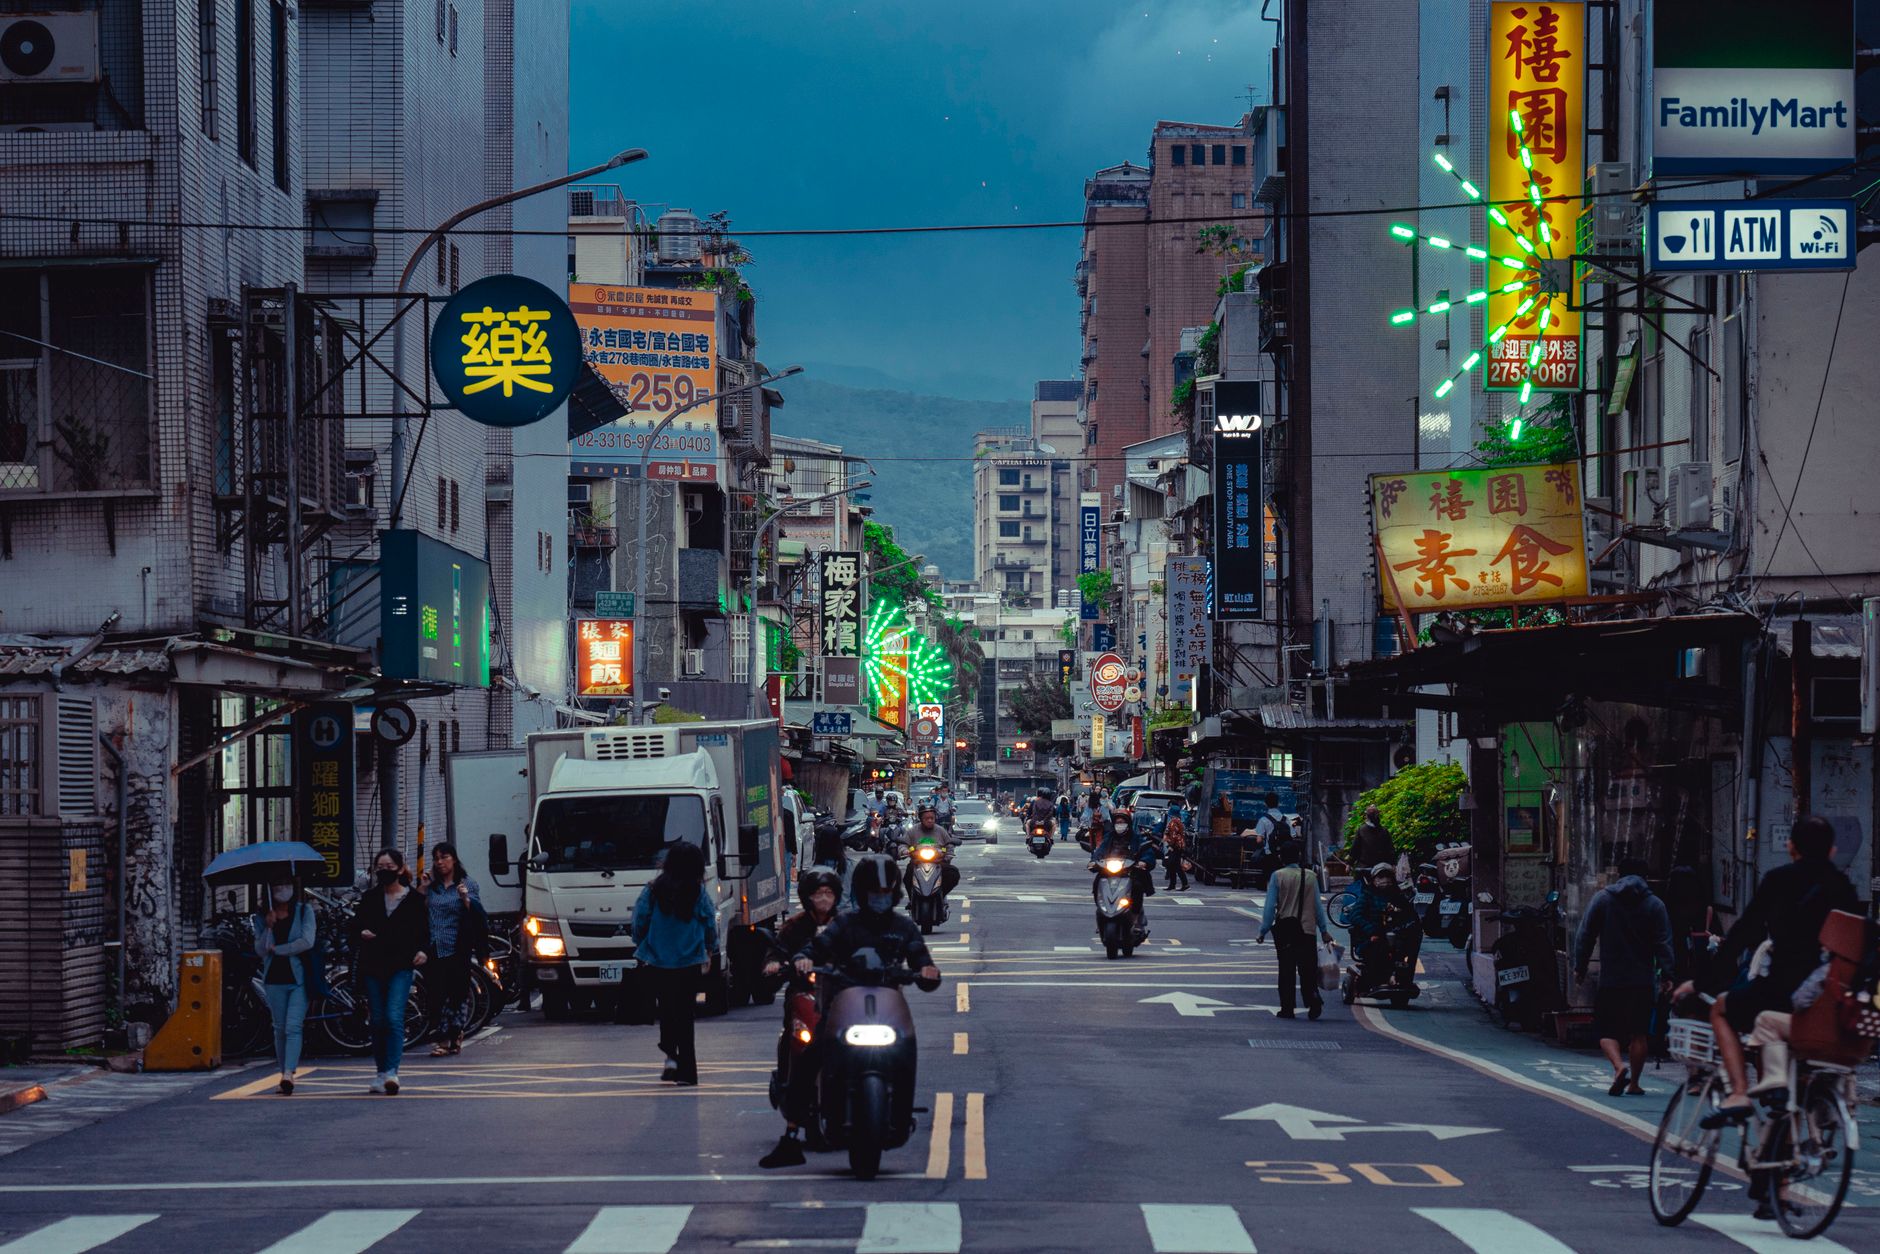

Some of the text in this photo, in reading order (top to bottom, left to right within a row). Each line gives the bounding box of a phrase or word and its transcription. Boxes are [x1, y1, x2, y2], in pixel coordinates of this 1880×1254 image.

[1660, 97, 1848, 136] FamilyMart
[1729, 216, 1777, 253] ATM
[1800, 241, 1839, 254] Wi-Fi
[646, 294, 669, 305] 先誠實
[671, 296, 693, 306] 再成交
[460, 304, 554, 398] 藥
[589, 327, 710, 353] 永吉國宅/富台國宅
[1490, 362, 1578, 384] 2753-0187
[1226, 463, 1234, 480] ONE
[1226, 480, 1234, 500] STOP
[1428, 473, 1528, 522] 禧園
[1226, 529, 1234, 549] AREA
[1392, 524, 1575, 602] 素食
[1472, 583, 1510, 597] 2753-0187
[1478, 570, 1502, 584] 電話
[823, 556, 857, 657] 梅家檳
[582, 621, 630, 640] 張家
[589, 640, 622, 685] 麵飯
[312, 760, 341, 878] 躍獅藥局
[1244, 1160, 1465, 1188] 30
